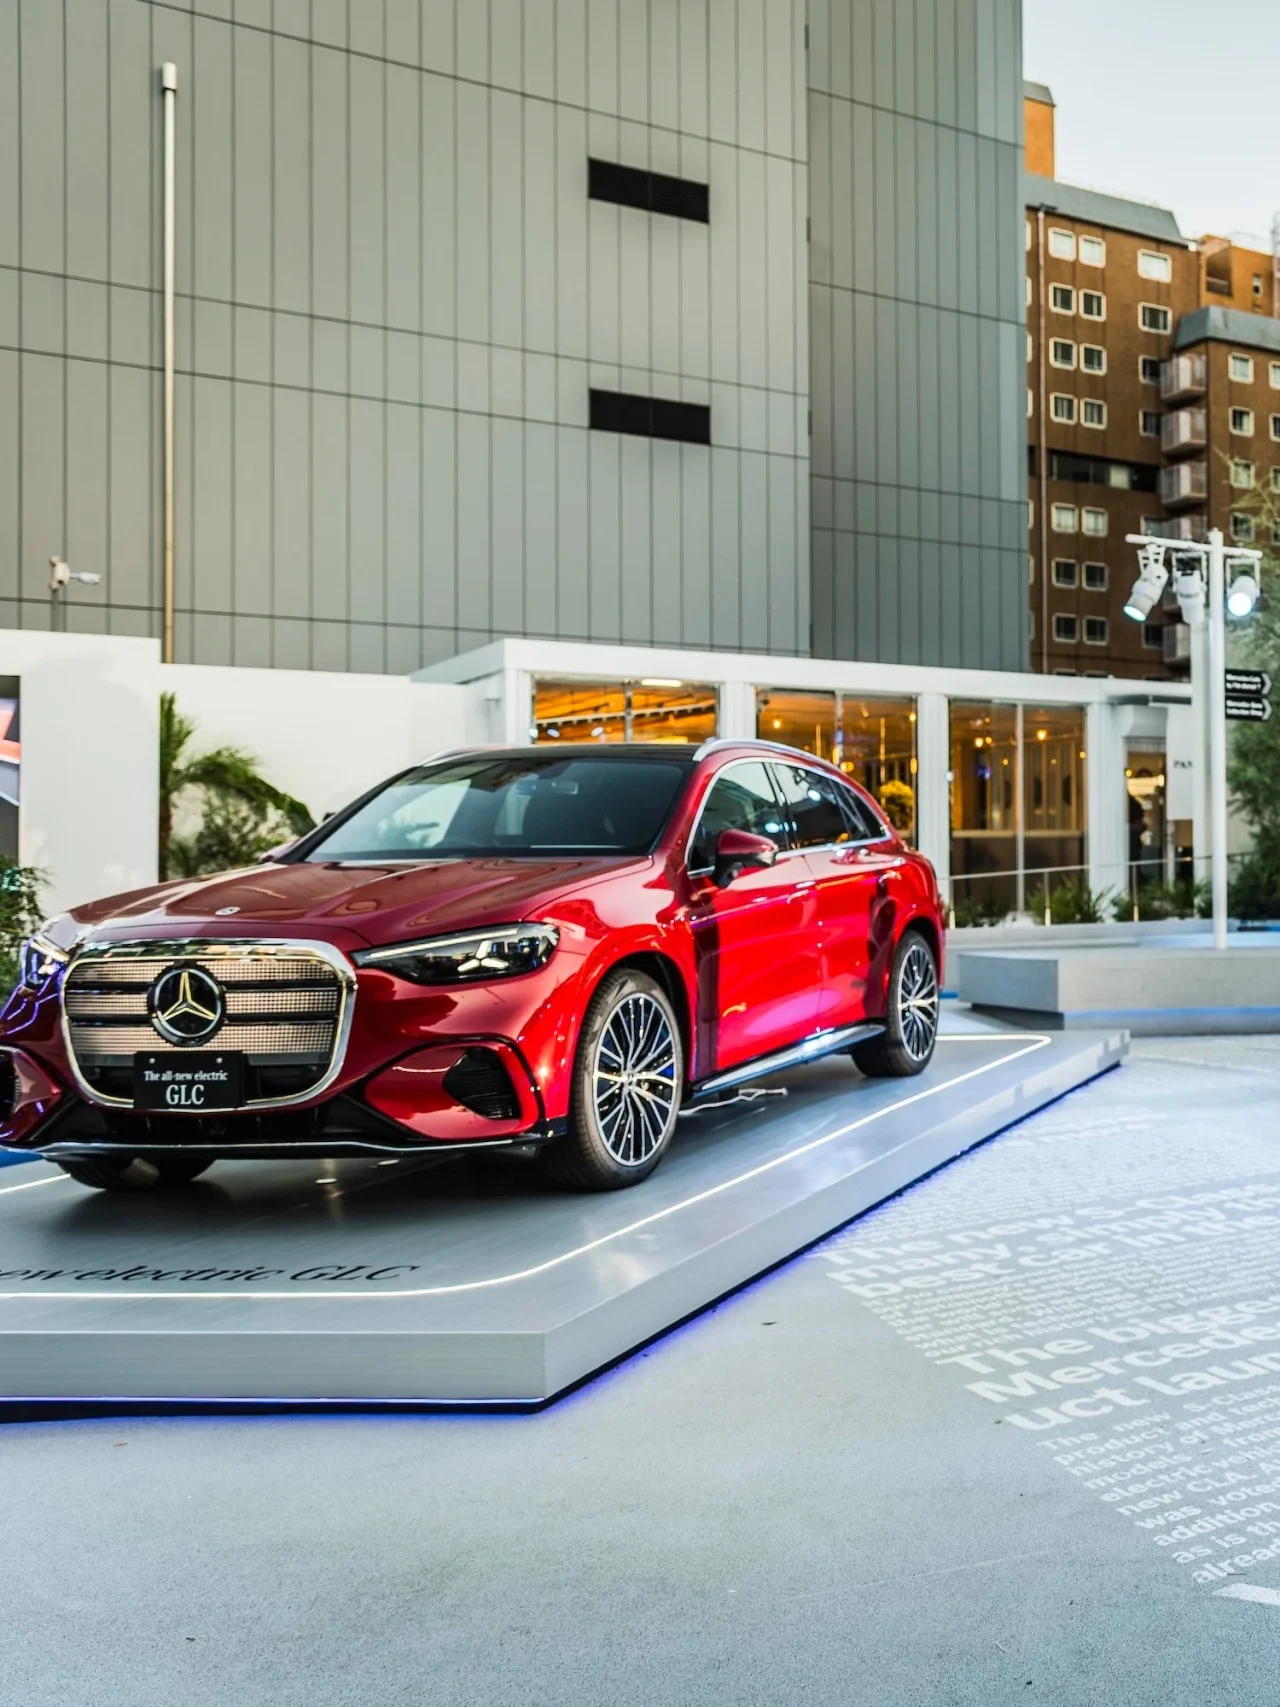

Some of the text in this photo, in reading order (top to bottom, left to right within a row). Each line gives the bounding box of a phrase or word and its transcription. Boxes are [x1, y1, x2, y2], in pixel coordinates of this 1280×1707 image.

[145, 1069, 228, 1081] The all-new electric
[166, 1084, 205, 1105] GLC
[812, 1215, 1075, 1266] The new
[74, 1265, 421, 1281] electric GLC
[824, 1242, 1037, 1284] many,
[841, 1262, 1016, 1299] best
[1017, 1242, 1114, 1267] car
[1111, 1232, 1186, 1248] in
[932, 1338, 1095, 1374] The
[1005, 1386, 1151, 1431] uct
[1036, 1432, 1099, 1451] The
[1112, 1412, 1172, 1432] new
[1052, 1426, 1172, 1466] product
[1174, 1410, 1228, 1431] and
[1064, 1440, 1175, 1477] history
[1179, 1429, 1210, 1445] of
[1082, 1453, 1193, 1489] models
[1099, 1464, 1213, 1502] electric
[1115, 1490, 1183, 1516] new
[1186, 1470, 1258, 1493] CLA.
[1133, 1505, 1202, 1530] was
[1171, 1544, 1212, 1564] as
[1209, 1533, 1248, 1549] is
